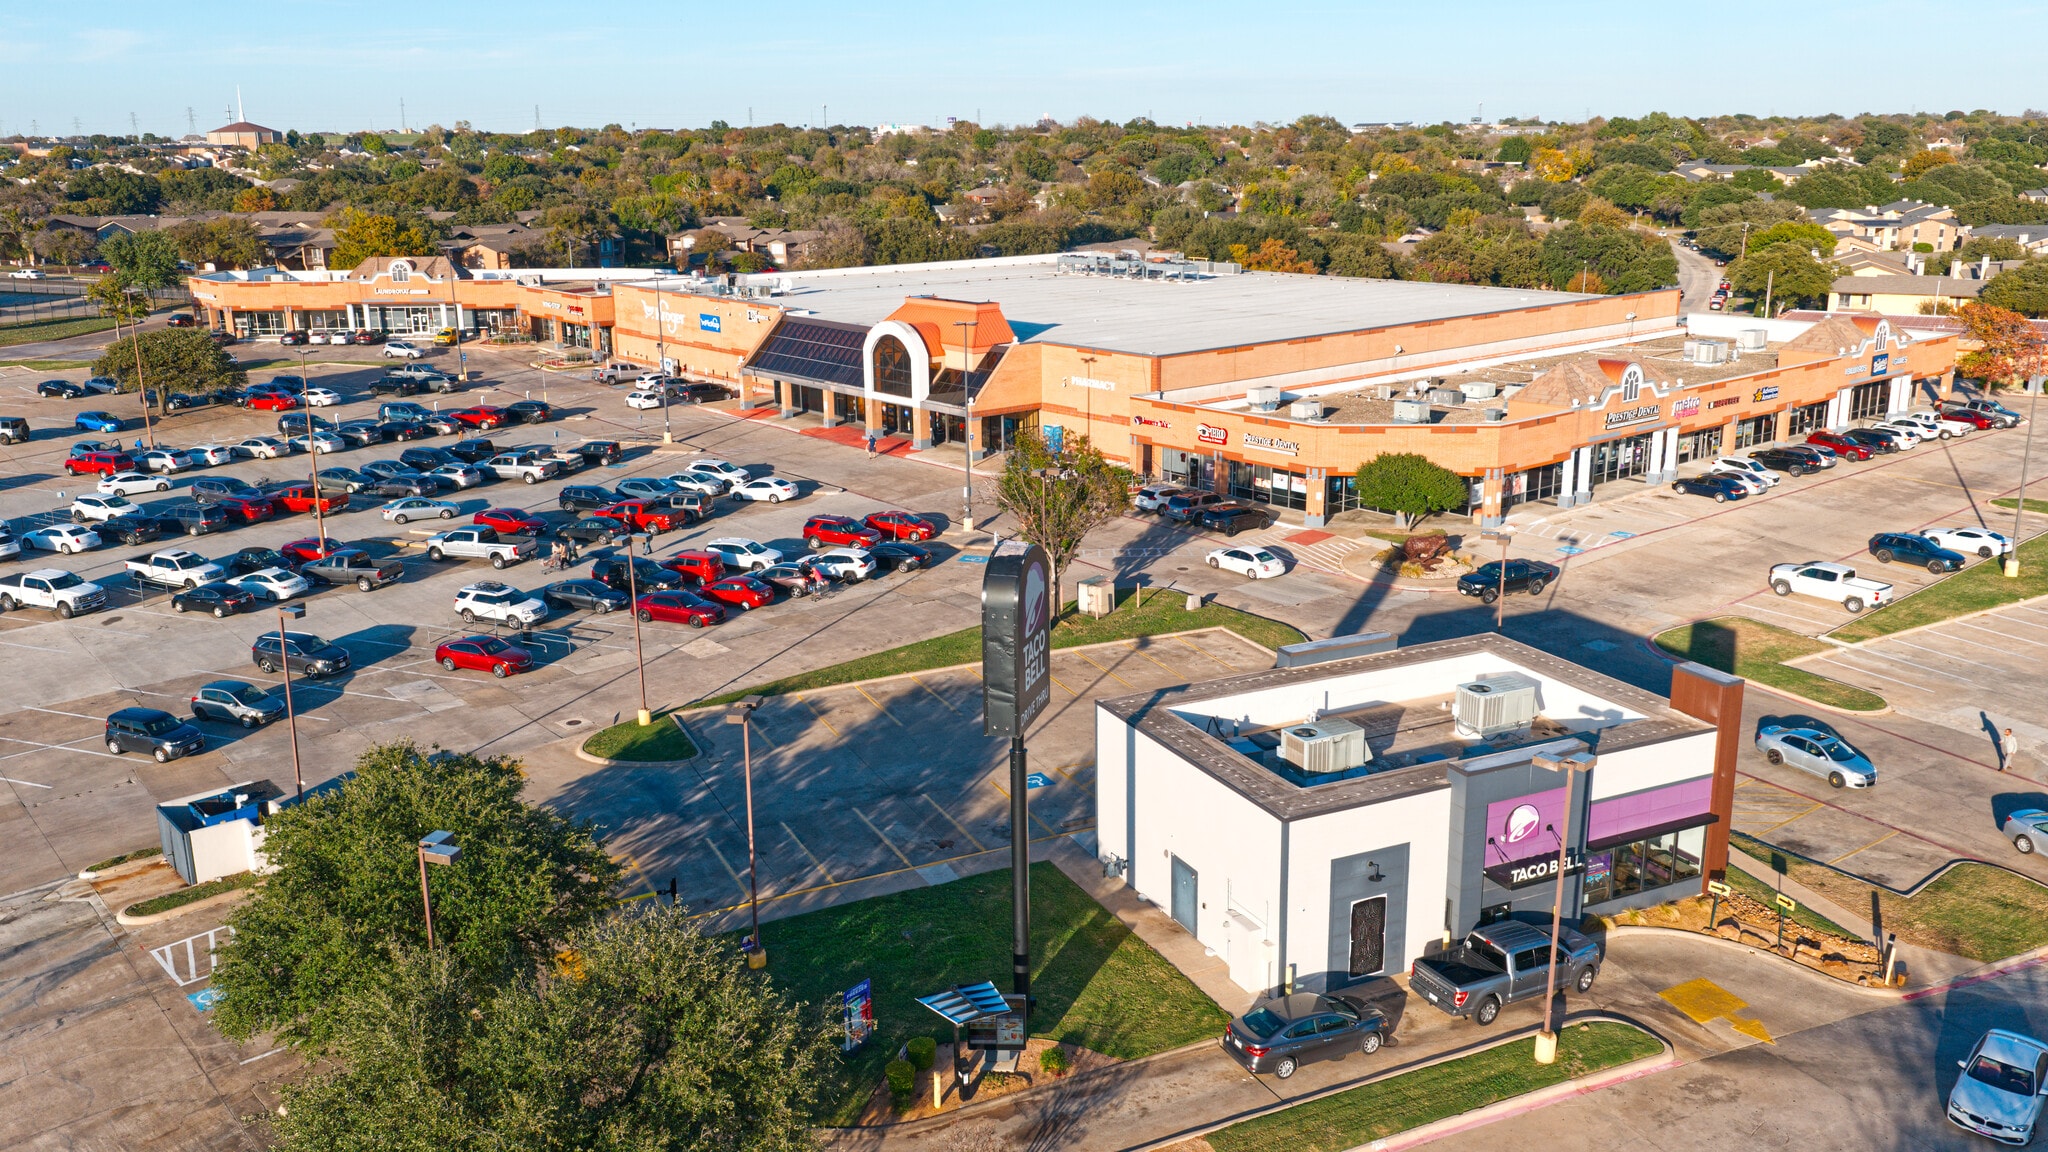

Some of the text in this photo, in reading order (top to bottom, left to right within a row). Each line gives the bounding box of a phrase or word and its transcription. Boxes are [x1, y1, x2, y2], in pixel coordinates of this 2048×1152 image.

[655, 300, 686, 334] Kroger
[1071, 375, 1116, 392] PHARMACY
[1607, 404, 1660, 423] PRESTIGE DENTAL
[1675, 395, 1700, 412] metro
[1243, 433, 1300, 450] PRESTIGE DENTAL
[1023, 629, 1046, 668] TACO
[1025, 653, 1046, 692] BELL
[1021, 685, 1049, 727] DRIVE THRU
[1511, 862, 1548, 883] TACO
[1549, 854, 1583, 874] BELL
